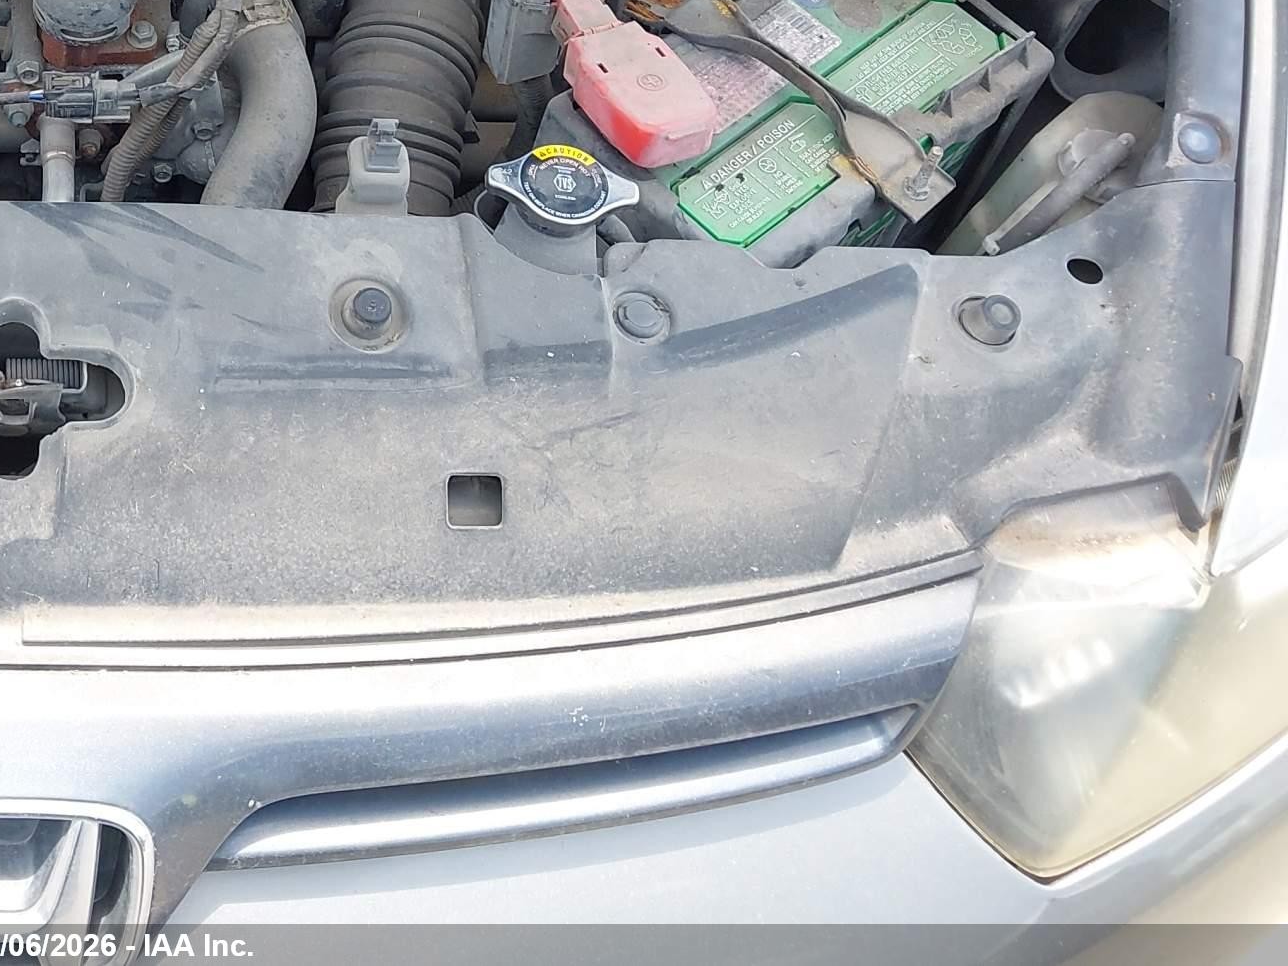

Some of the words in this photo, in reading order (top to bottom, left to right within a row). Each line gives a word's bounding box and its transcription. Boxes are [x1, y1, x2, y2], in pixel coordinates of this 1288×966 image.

[546, 147, 589, 162] CAUTION
[710, 150, 753, 183] DANGER
[756, 120, 796, 149] POISON
[539, 157, 559, 170] NEVER
[560, 157, 579, 168] OPEN
[558, 177, 572, 189] TVS
